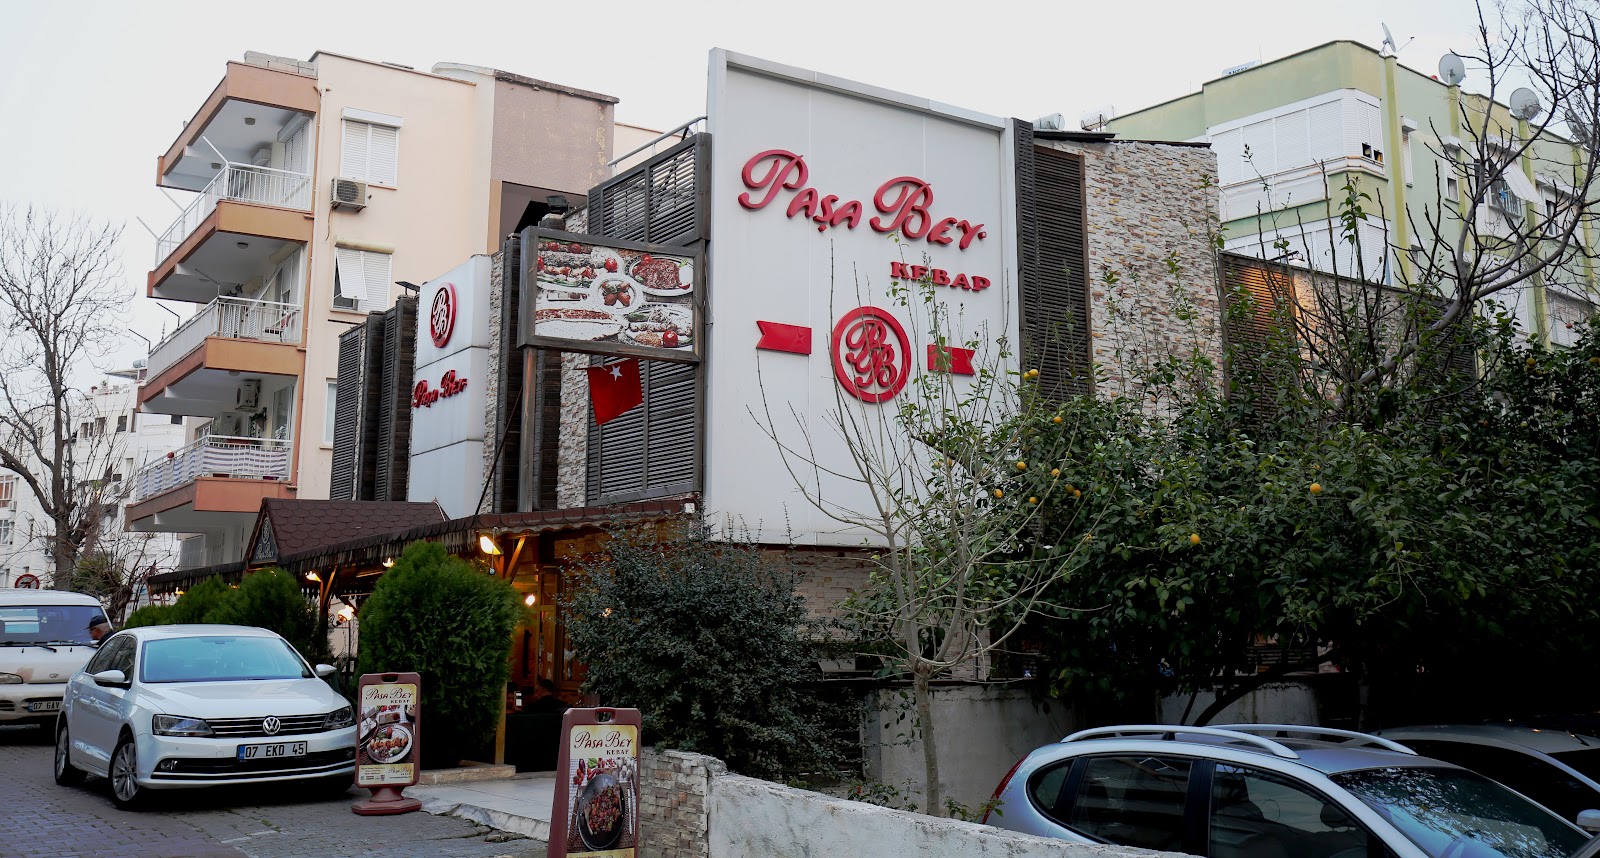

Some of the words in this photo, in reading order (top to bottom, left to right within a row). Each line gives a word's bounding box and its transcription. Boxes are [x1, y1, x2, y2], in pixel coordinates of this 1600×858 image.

[890, 261, 991, 292] KEBAP
[33, 702, 43, 710] 07
[245, 746, 258, 758] 07
[265, 744, 285, 757] EKD
[292, 743, 304, 755] 45
